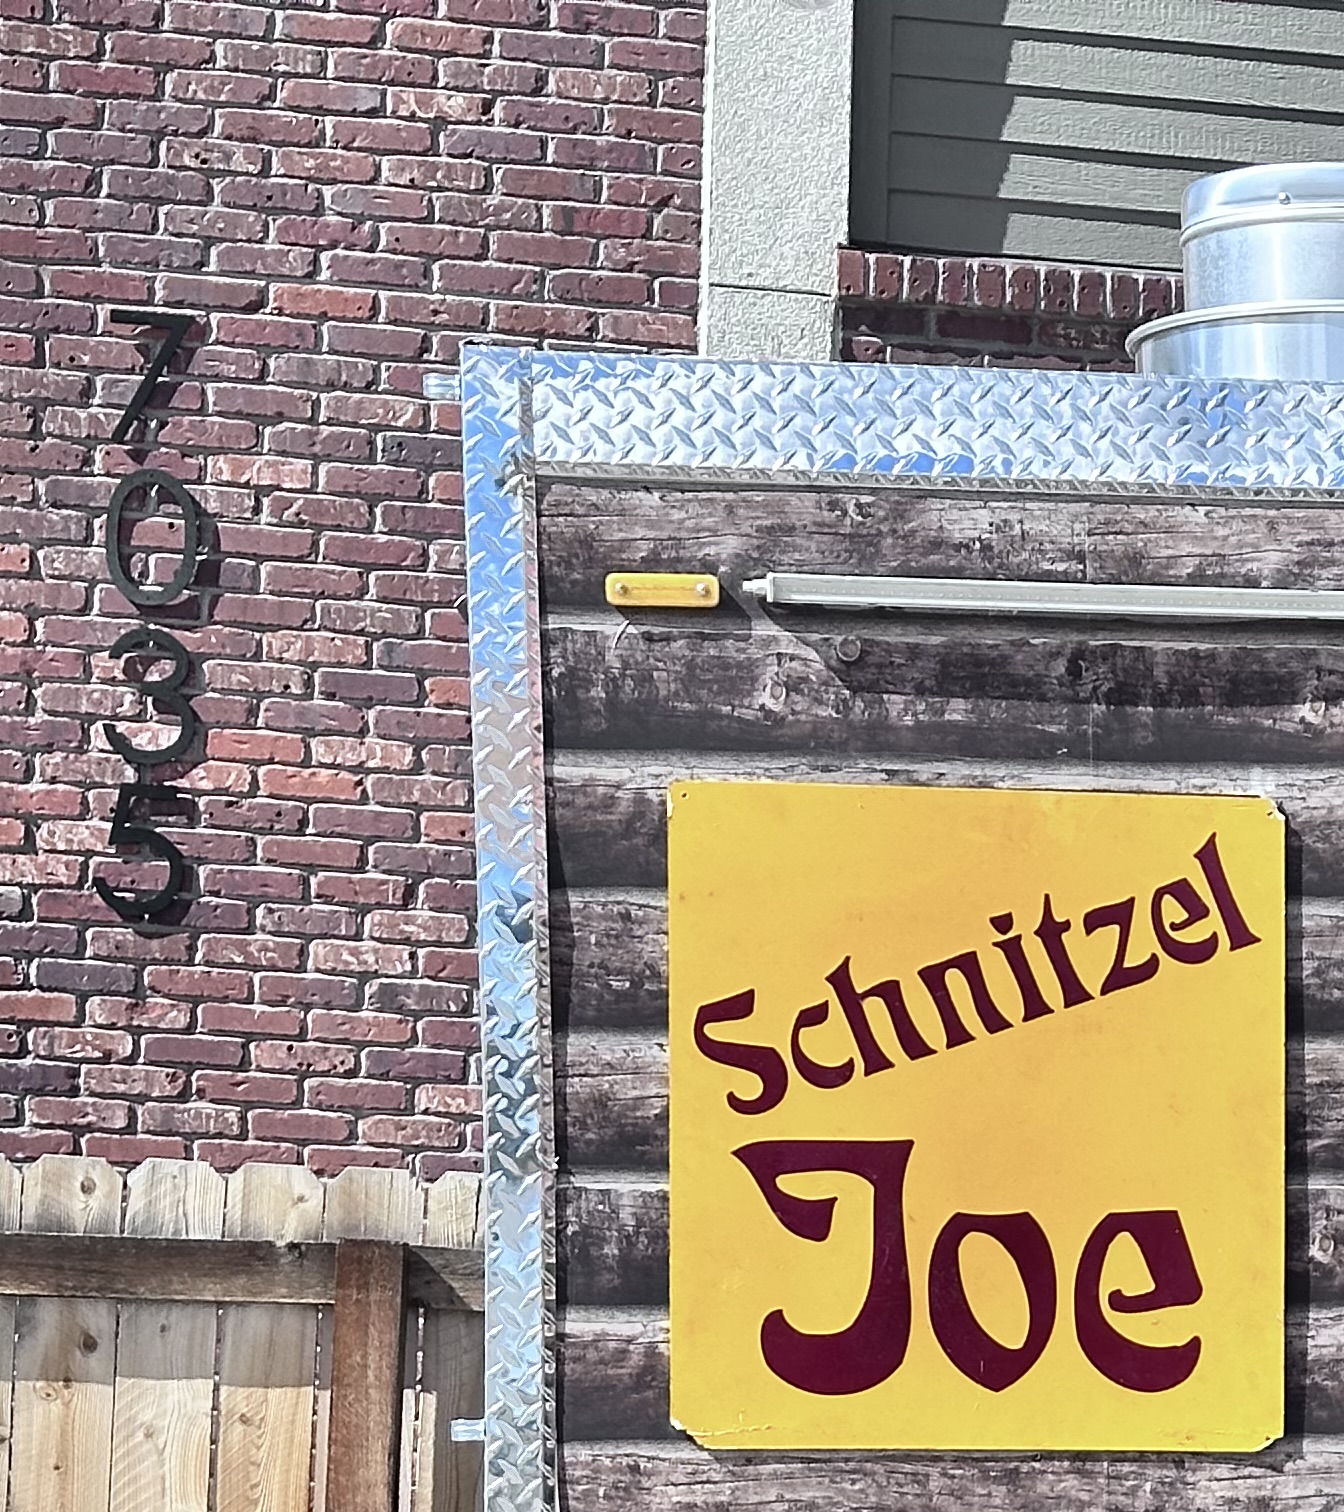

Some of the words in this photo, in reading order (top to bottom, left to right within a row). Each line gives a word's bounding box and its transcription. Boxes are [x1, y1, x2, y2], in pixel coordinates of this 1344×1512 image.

[93, 309, 199, 917] 7035
[693, 831, 1263, 1116] Schnitzel
[730, 1138, 1204, 1396] Joe
